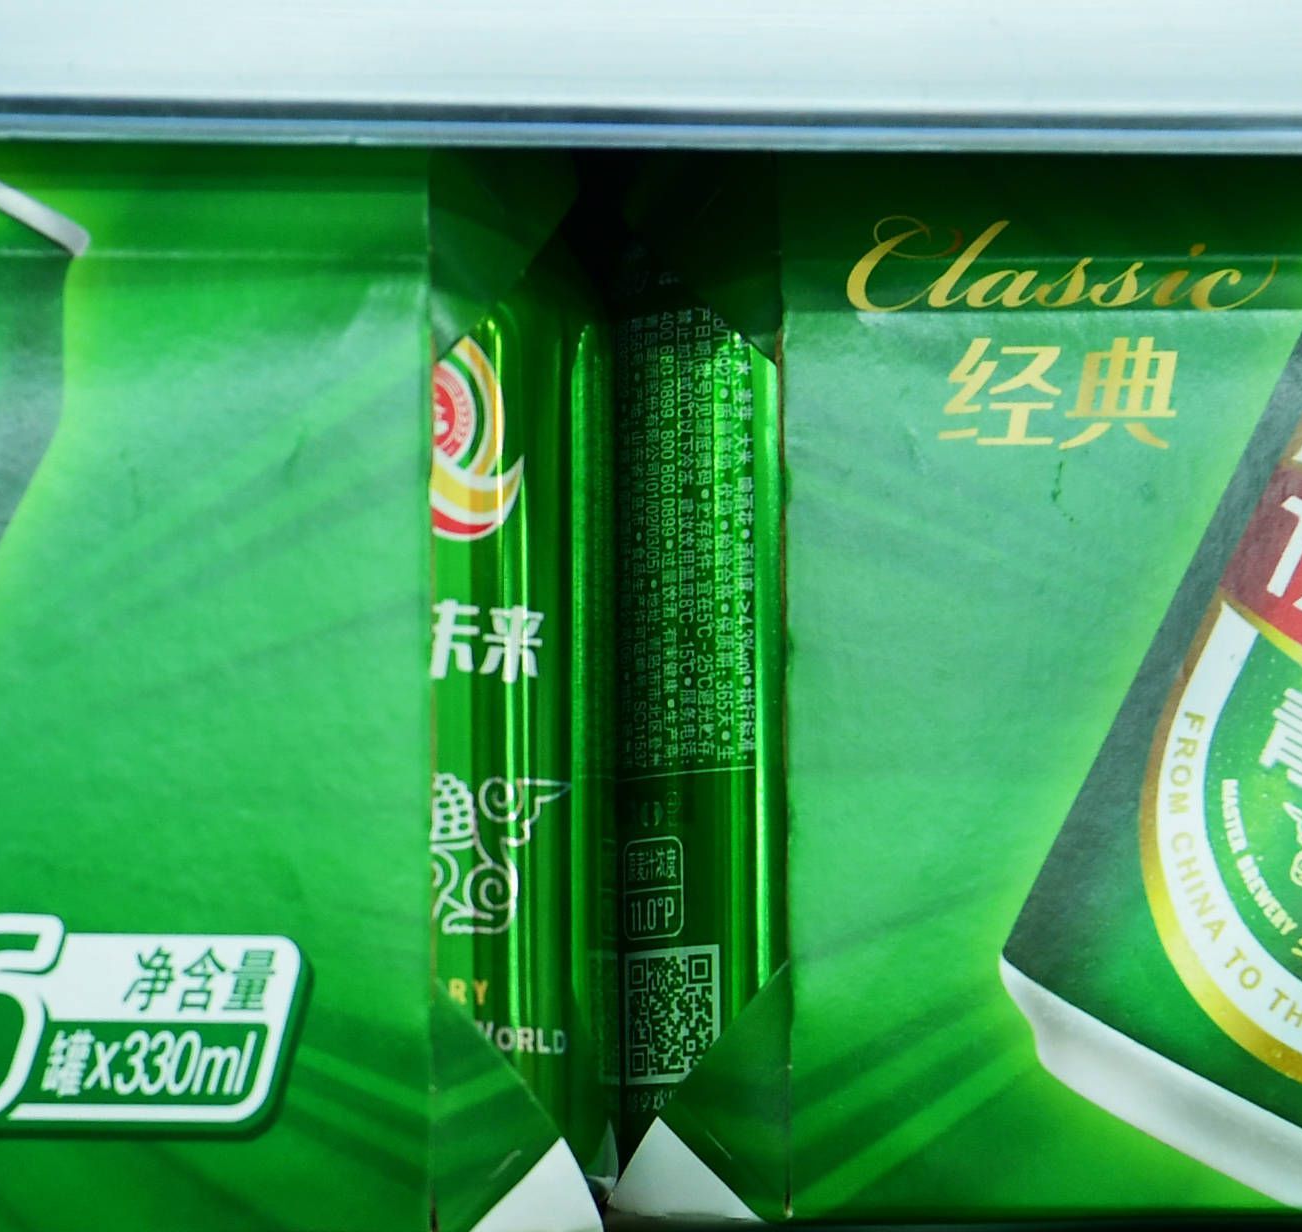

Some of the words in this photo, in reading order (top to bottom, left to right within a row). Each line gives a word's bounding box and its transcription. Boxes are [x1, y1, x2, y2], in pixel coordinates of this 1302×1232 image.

[846, 214, 1279, 313] Classic
[938, 337, 1178, 450] 经典
[1168, 711, 1206, 814] FROM
[1171, 831, 1227, 942] CHINA
[124, 945, 276, 1014] 净含量
[1224, 947, 1262, 990] TO
